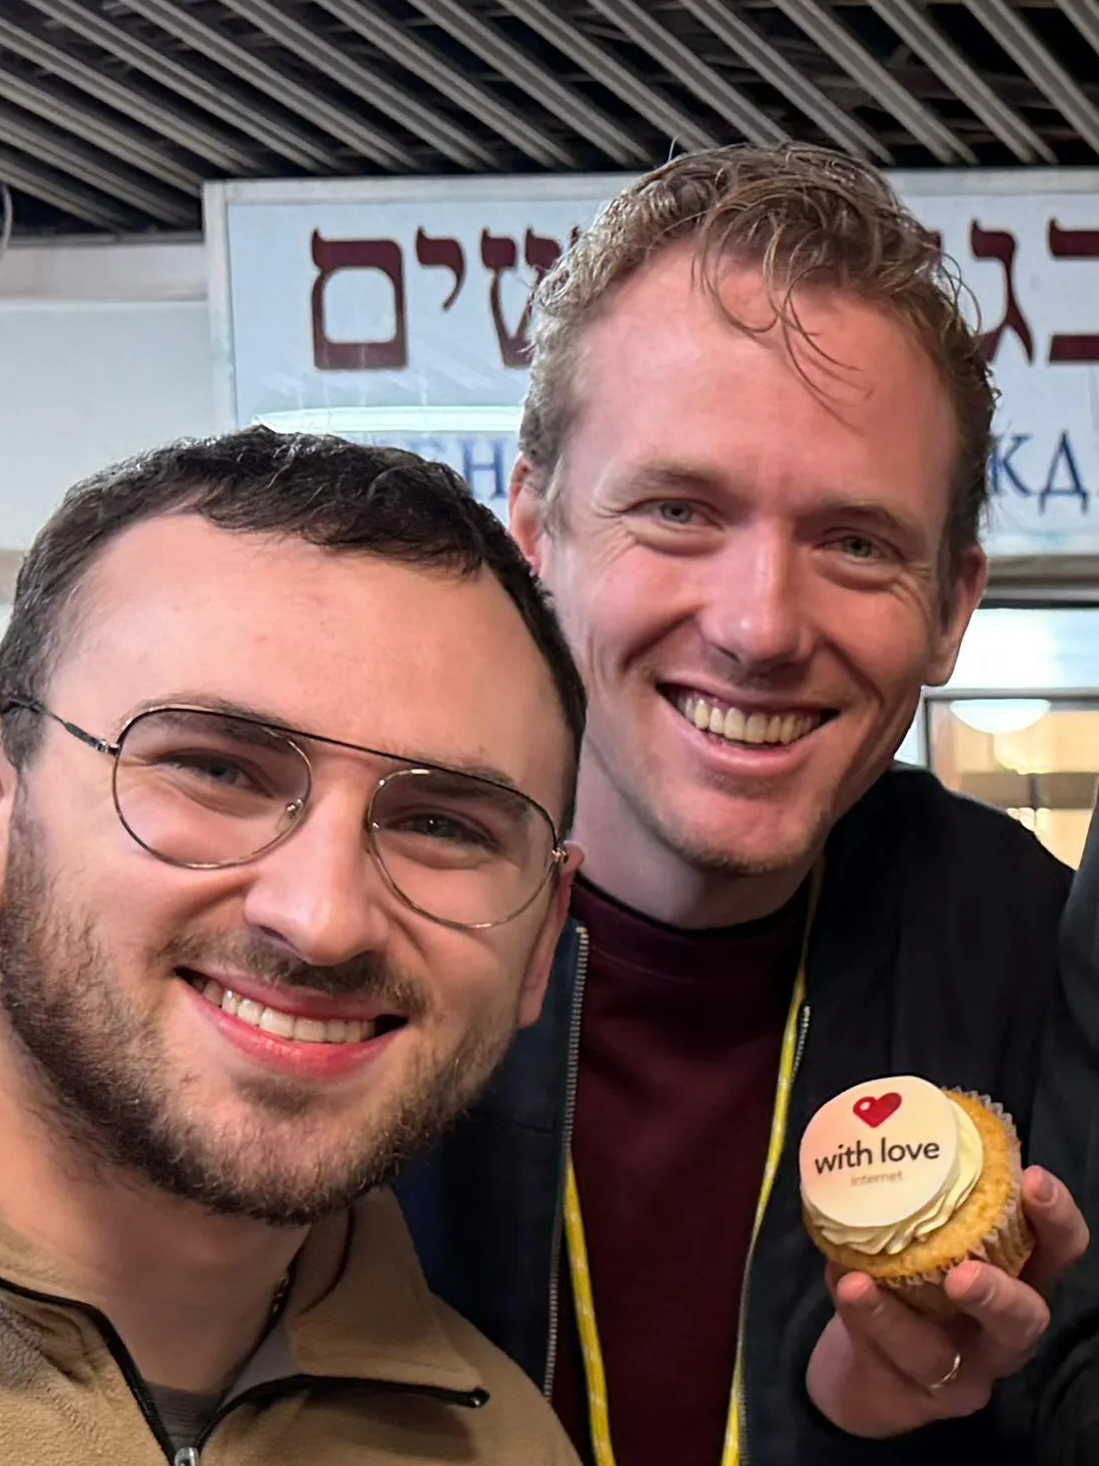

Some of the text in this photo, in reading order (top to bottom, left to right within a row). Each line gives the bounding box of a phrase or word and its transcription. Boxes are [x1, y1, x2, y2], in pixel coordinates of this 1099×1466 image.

[311, 224, 579, 371] שים
[814, 1136, 940, 1175] with love
[850, 1170, 904, 1187] internet
